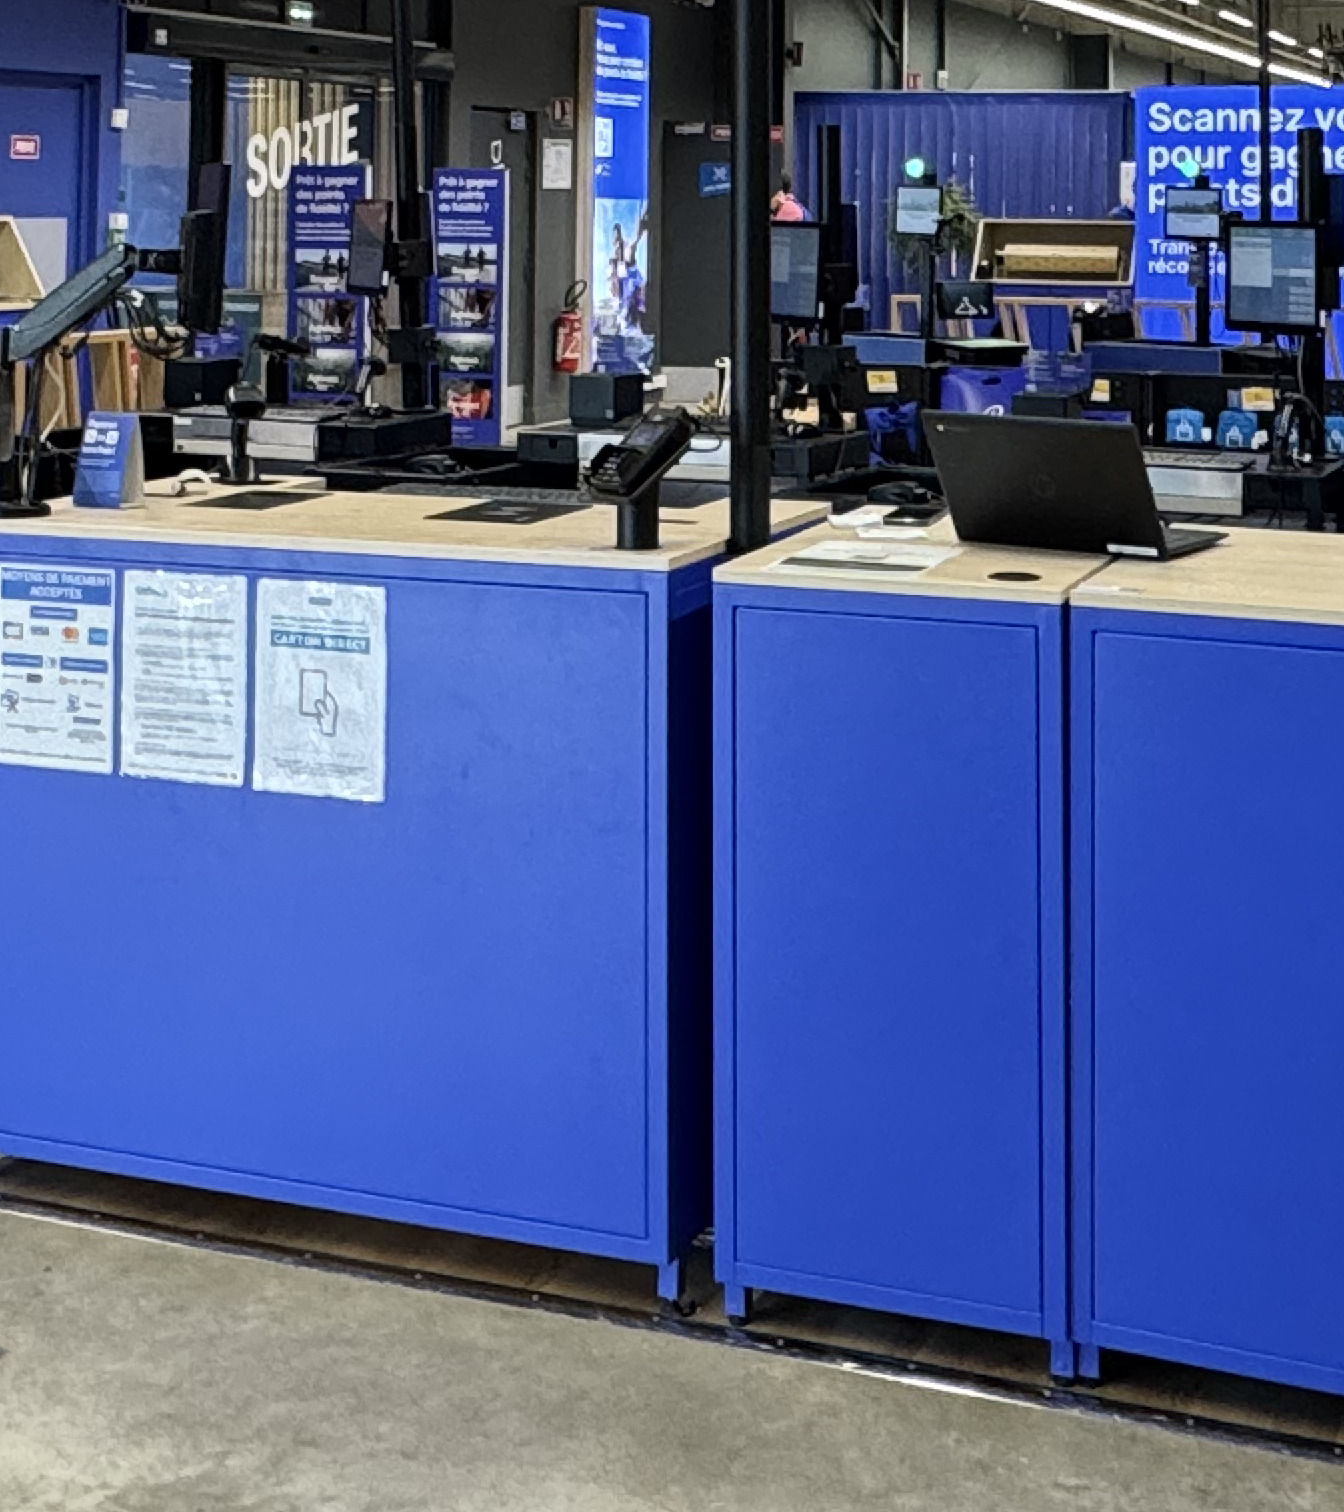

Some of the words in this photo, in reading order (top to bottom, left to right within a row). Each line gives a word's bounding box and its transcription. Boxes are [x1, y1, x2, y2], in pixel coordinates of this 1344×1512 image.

[1148, 103, 1304, 132] Scannez
[246, 103, 359, 197] SORTIE
[1148, 144, 1232, 176] pour
